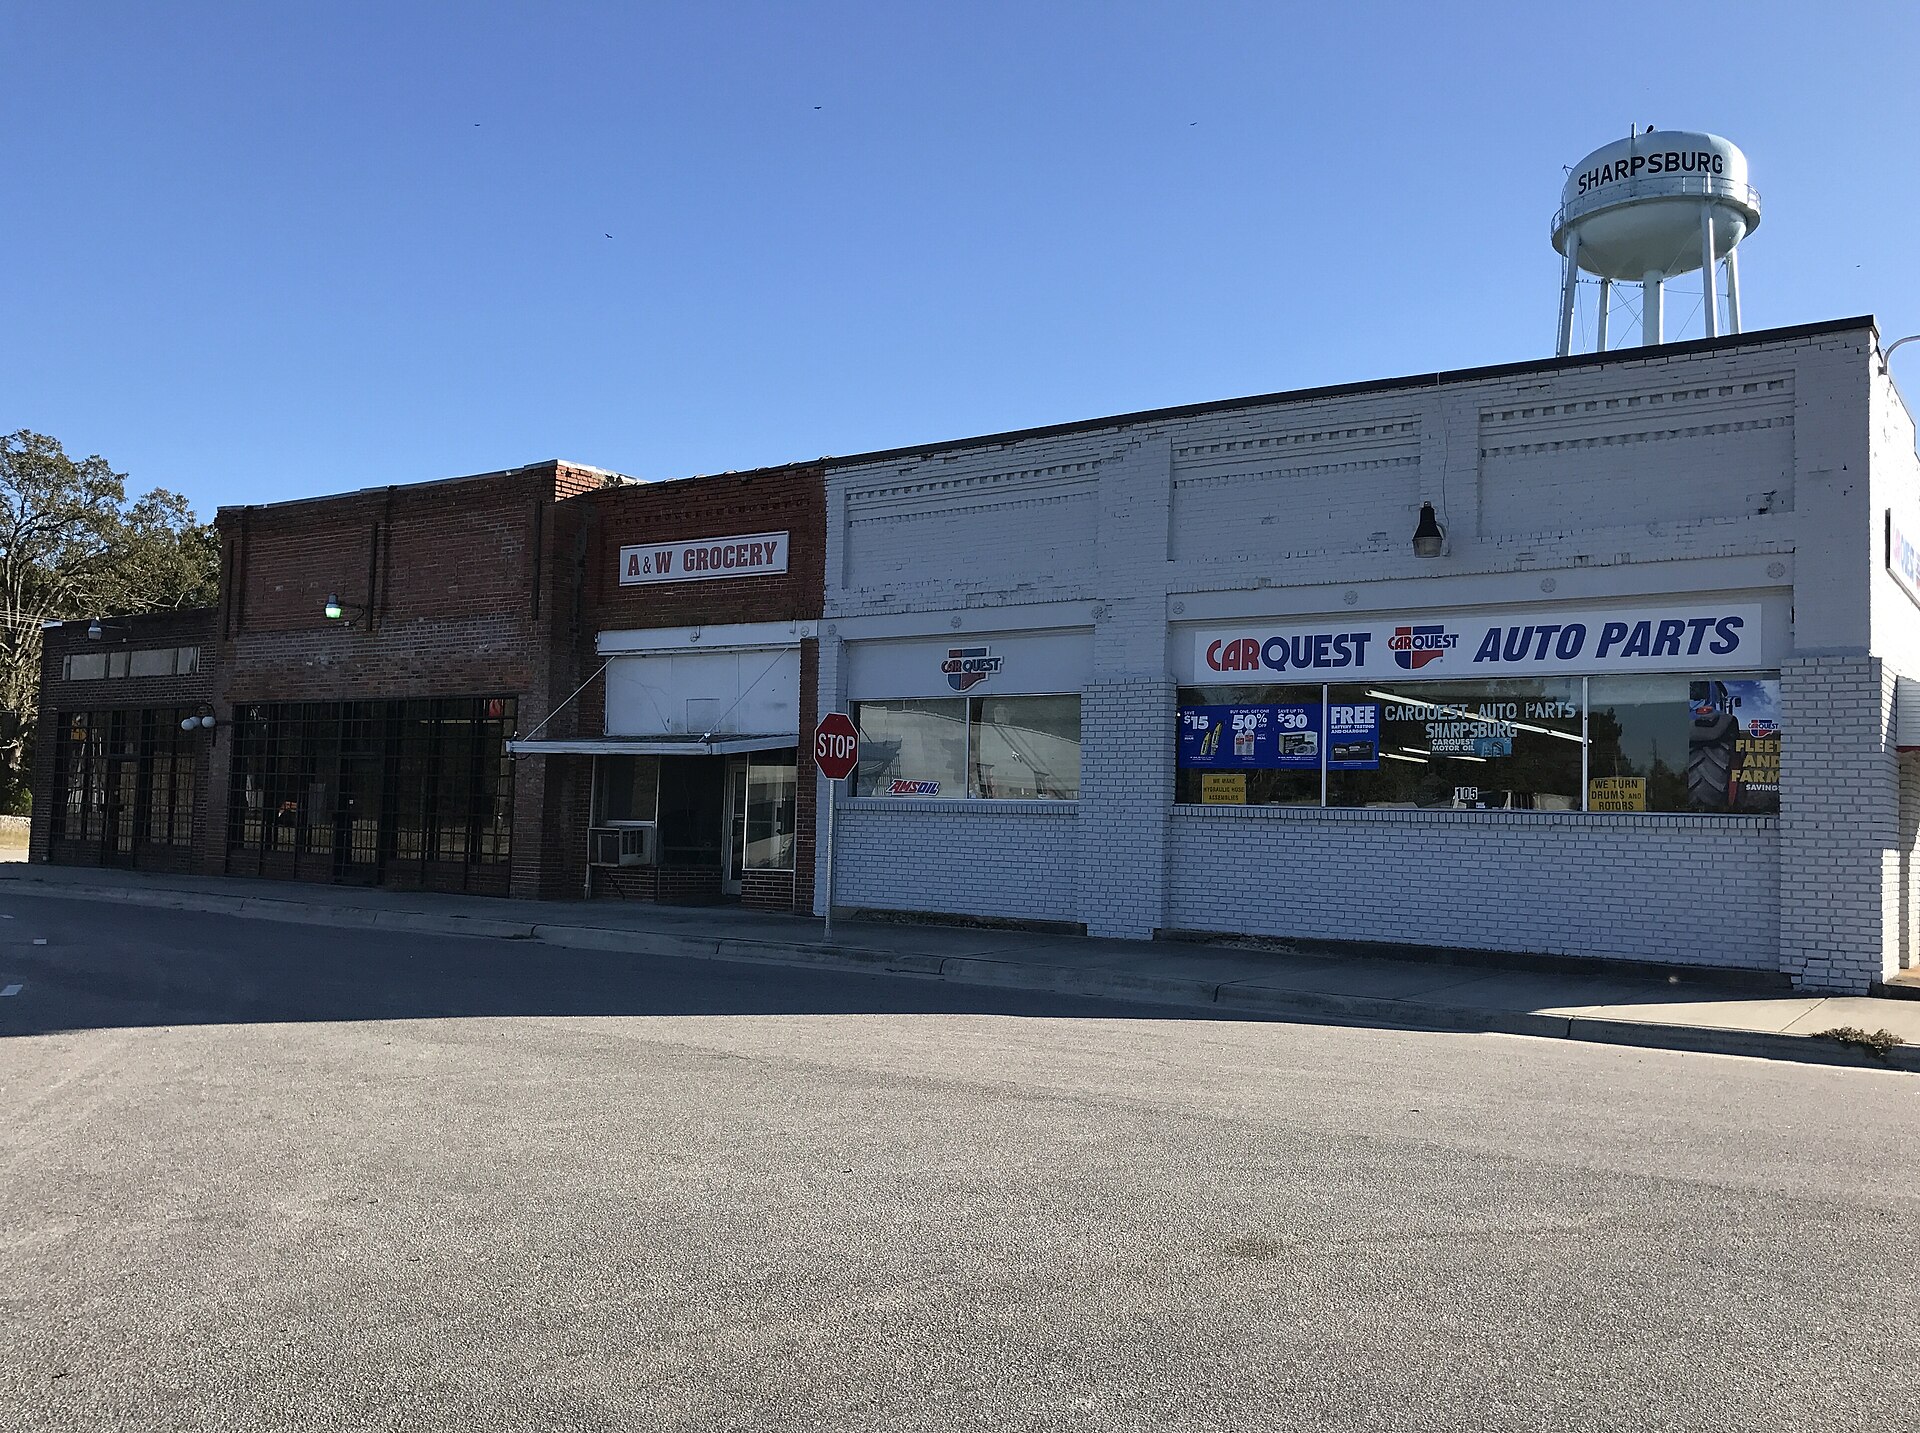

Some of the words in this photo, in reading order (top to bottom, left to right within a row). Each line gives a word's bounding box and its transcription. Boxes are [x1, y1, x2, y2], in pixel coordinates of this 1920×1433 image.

[1577, 151, 1723, 196] SHARPSBURG
[626, 554, 640, 577] A
[642, 557, 652, 573] &
[654, 551, 673, 574] W
[683, 541, 778, 572] GROCERY
[1387, 634, 1460, 651] CARQUEST
[1472, 623, 1588, 663] AUTO
[1595, 616, 1745, 659] PARTS
[1206, 632, 1372, 672] CARQUEST
[940, 656, 1001, 674] CARQUEST
[1330, 706, 1375, 725] FREE
[1385, 703, 1469, 721] CARQUEST
[1478, 703, 1518, 719] AUTO
[1525, 701, 1576, 719] PARTS
[1184, 715, 1209, 730] $15
[1277, 714, 1308, 729] $30
[1425, 721, 1518, 739] SHARPSBURG
[817, 733, 855, 759] STOP
[1431, 738, 1475, 746] CARQUEST
[1742, 754, 1780, 768] AND
[1594, 780, 1609, 789] WE
[1612, 780, 1638, 789] TURN
[1731, 769, 1780, 783] FARM
[888, 779, 939, 796] AMSOIL
[1456, 787, 1477, 800] 105
[1591, 790, 1625, 800] DRUMS
[1628, 792, 1642, 800] AND
[1598, 801, 1634, 811] ROTORS
